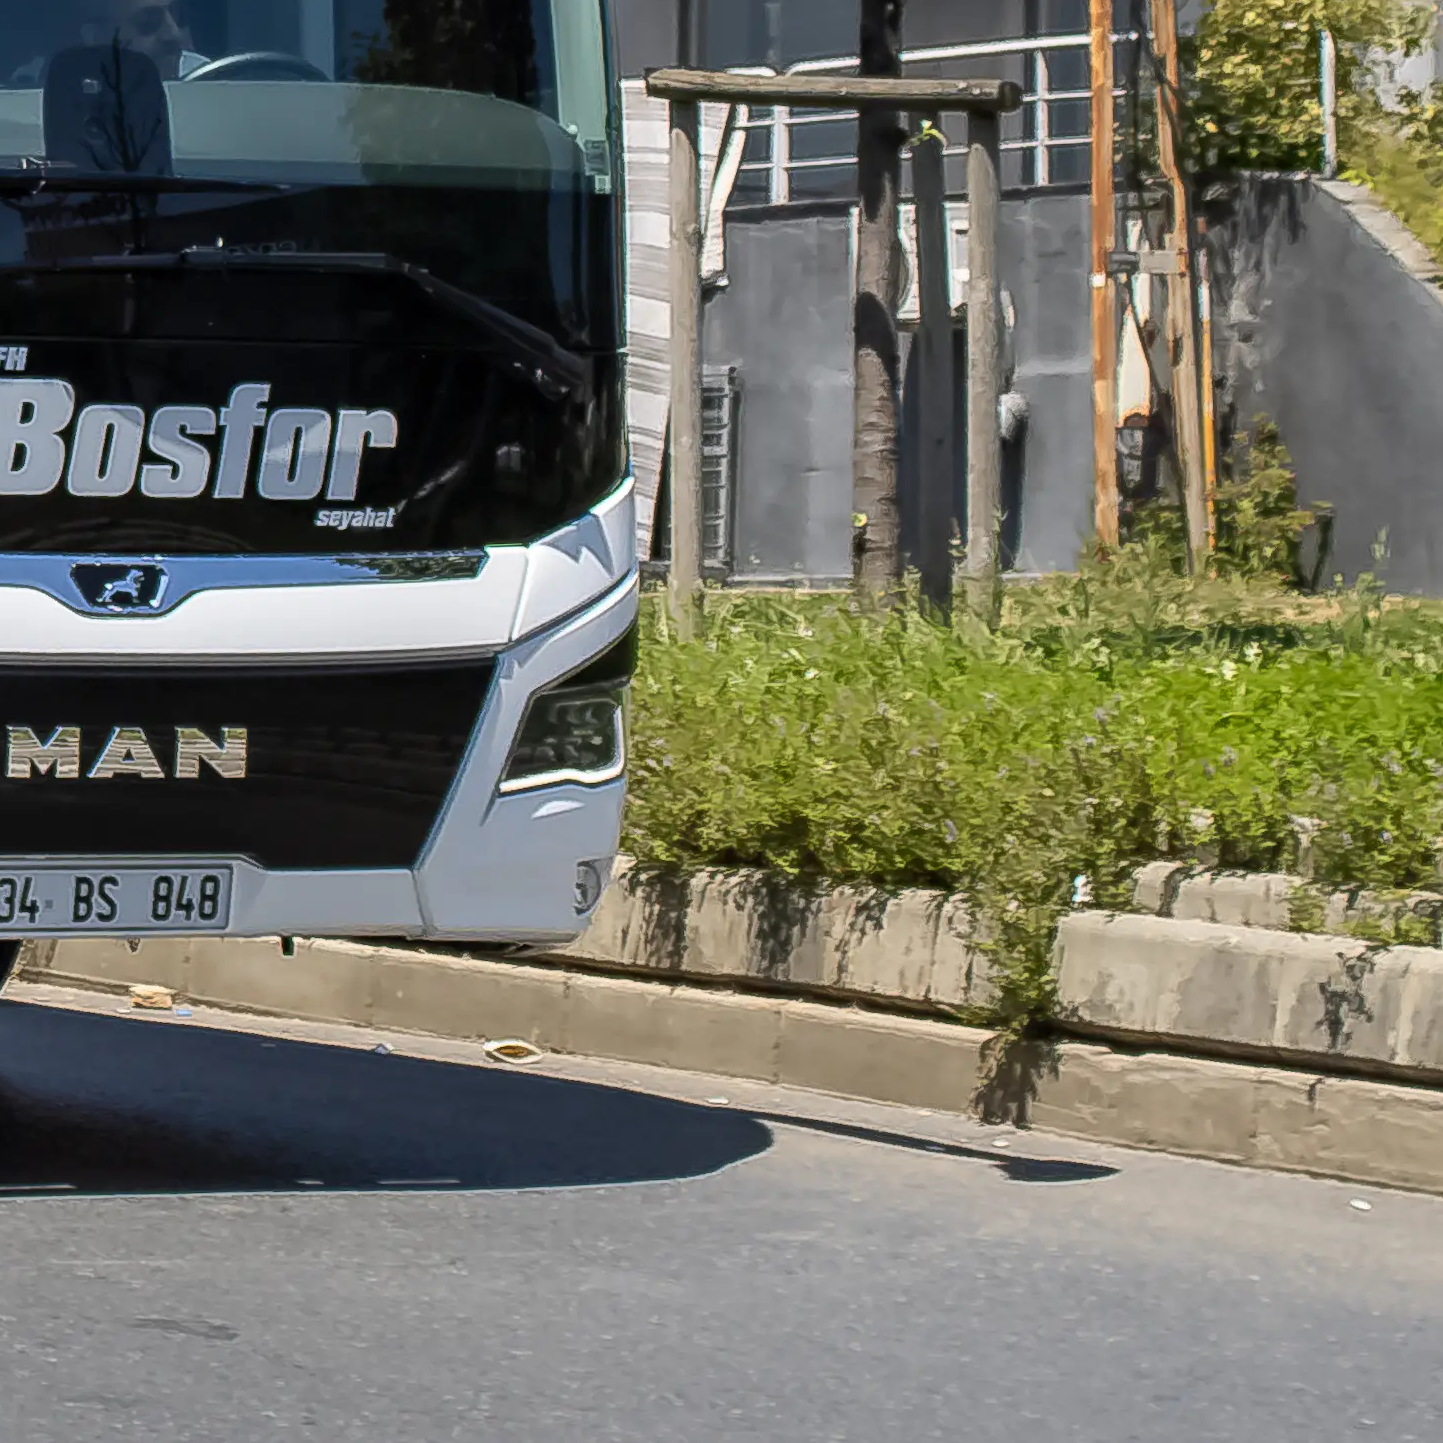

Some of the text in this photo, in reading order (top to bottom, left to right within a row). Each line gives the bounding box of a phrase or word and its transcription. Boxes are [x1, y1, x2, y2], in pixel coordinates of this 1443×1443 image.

[315, 506, 397, 529] seyahat
[5, 726, 249, 779] MAN
[71, 875, 120, 923] BS
[151, 875, 221, 922] 848
